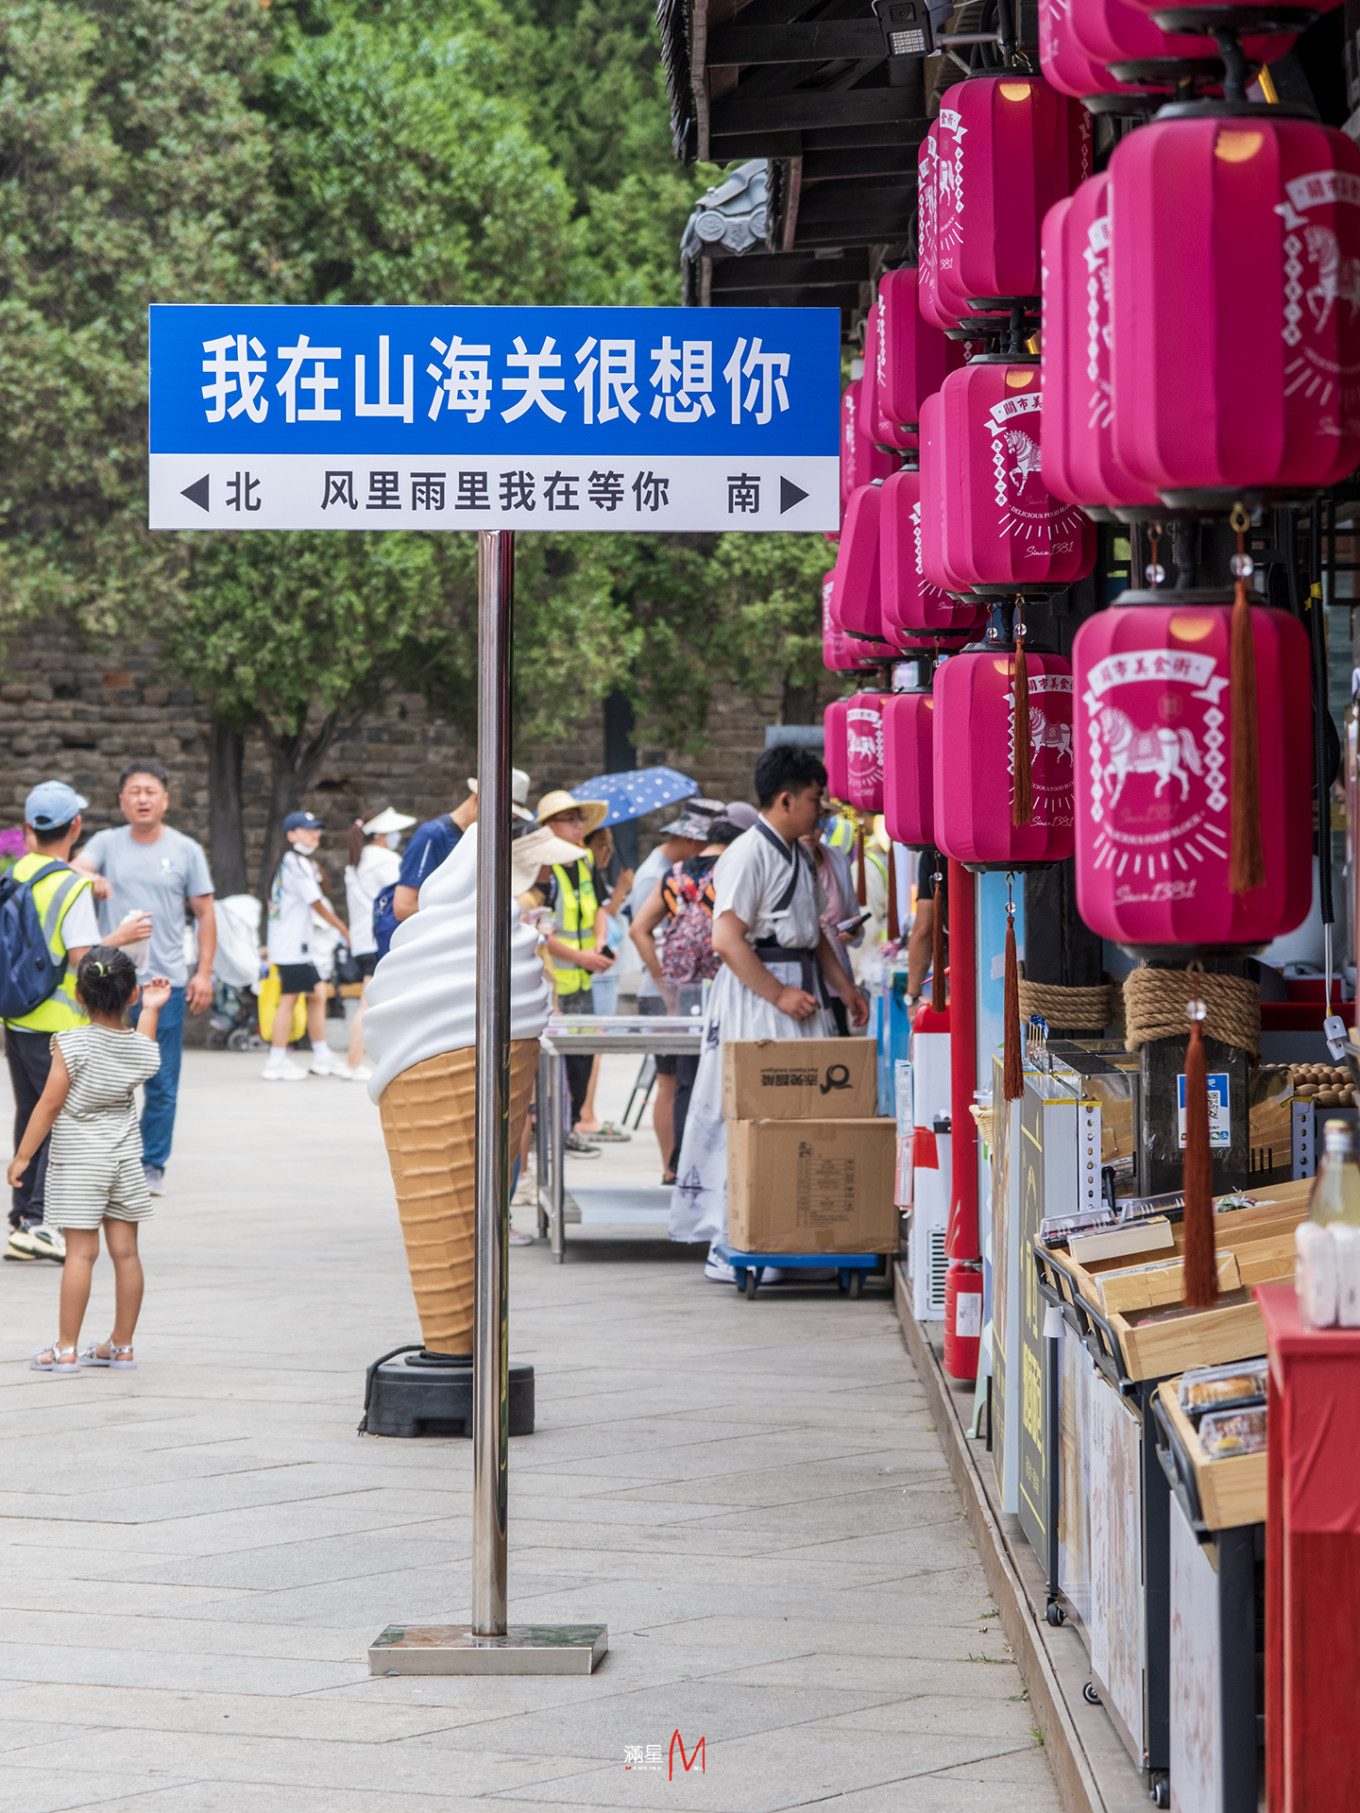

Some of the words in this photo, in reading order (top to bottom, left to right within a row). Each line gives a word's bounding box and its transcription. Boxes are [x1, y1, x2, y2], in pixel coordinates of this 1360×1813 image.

[201, 334, 791, 425] 我在山海关很想你
[225, 471, 262, 511] 北
[320, 470, 670, 512] 风里雨里我在等你
[727, 473, 761, 514] 南
